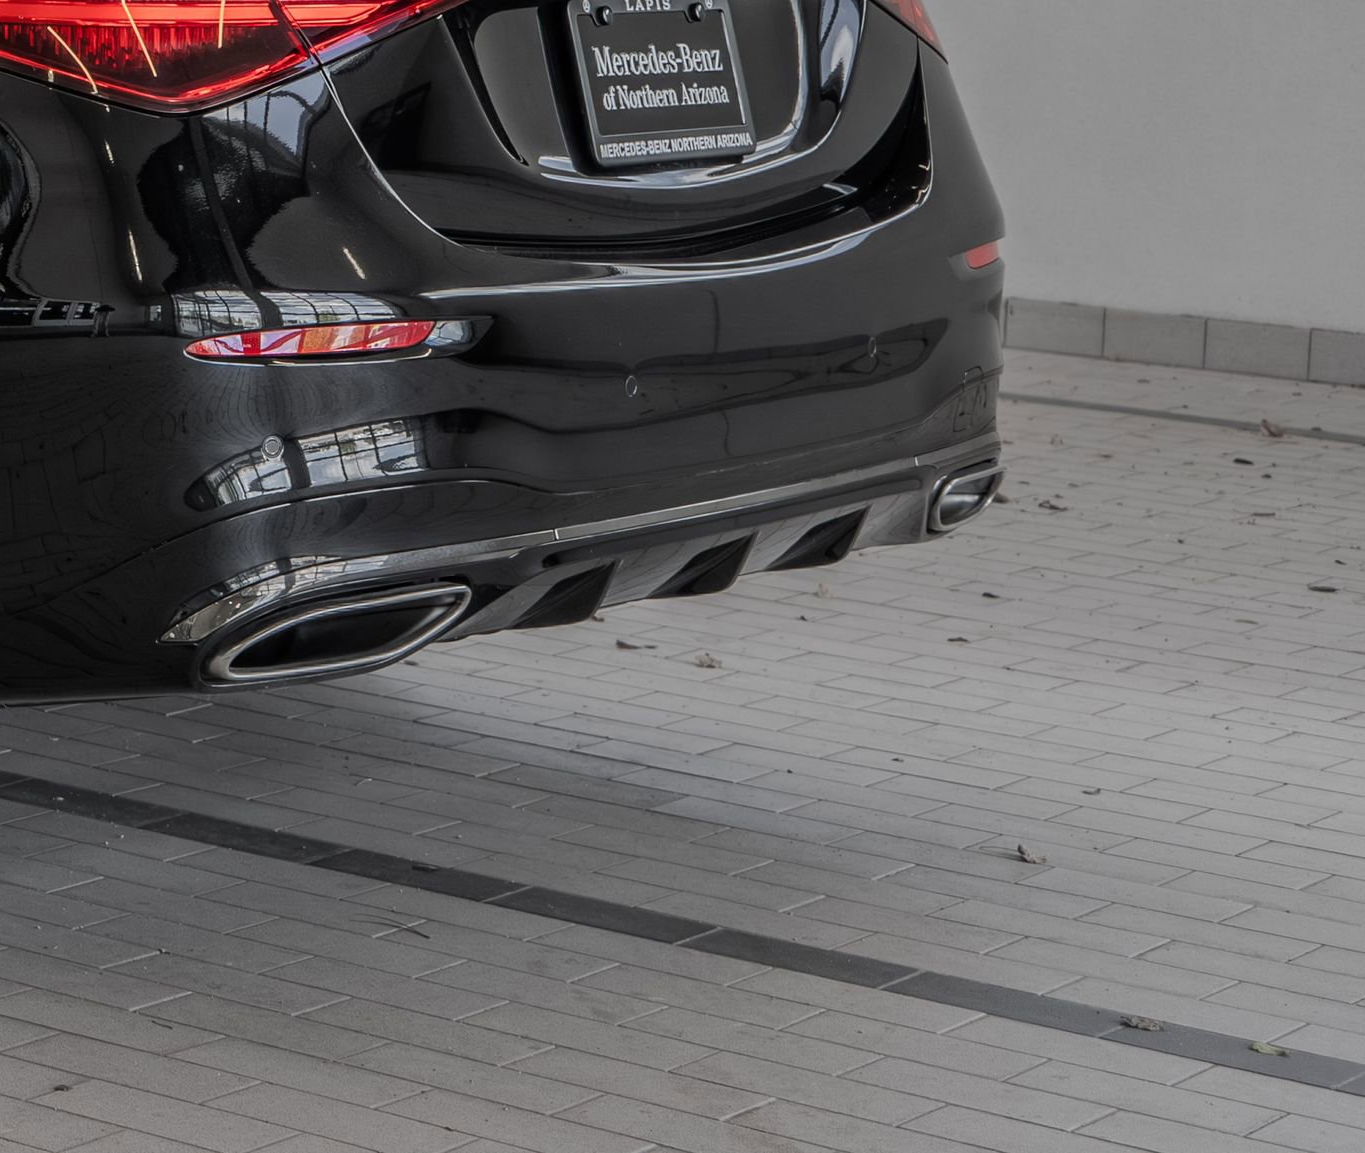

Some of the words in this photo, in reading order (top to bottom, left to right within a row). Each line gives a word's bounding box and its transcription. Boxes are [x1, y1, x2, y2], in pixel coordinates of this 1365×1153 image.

[591, 43, 724, 78] Mercedes-Benz
[602, 85, 617, 111] of
[616, 83, 679, 110] Northern
[680, 81, 730, 106] Arizona
[599, 139, 671, 159] MERCEDES-BENZ
[671, 135, 716, 153] NORTHERN
[717, 132, 754, 148] ARIZONA
